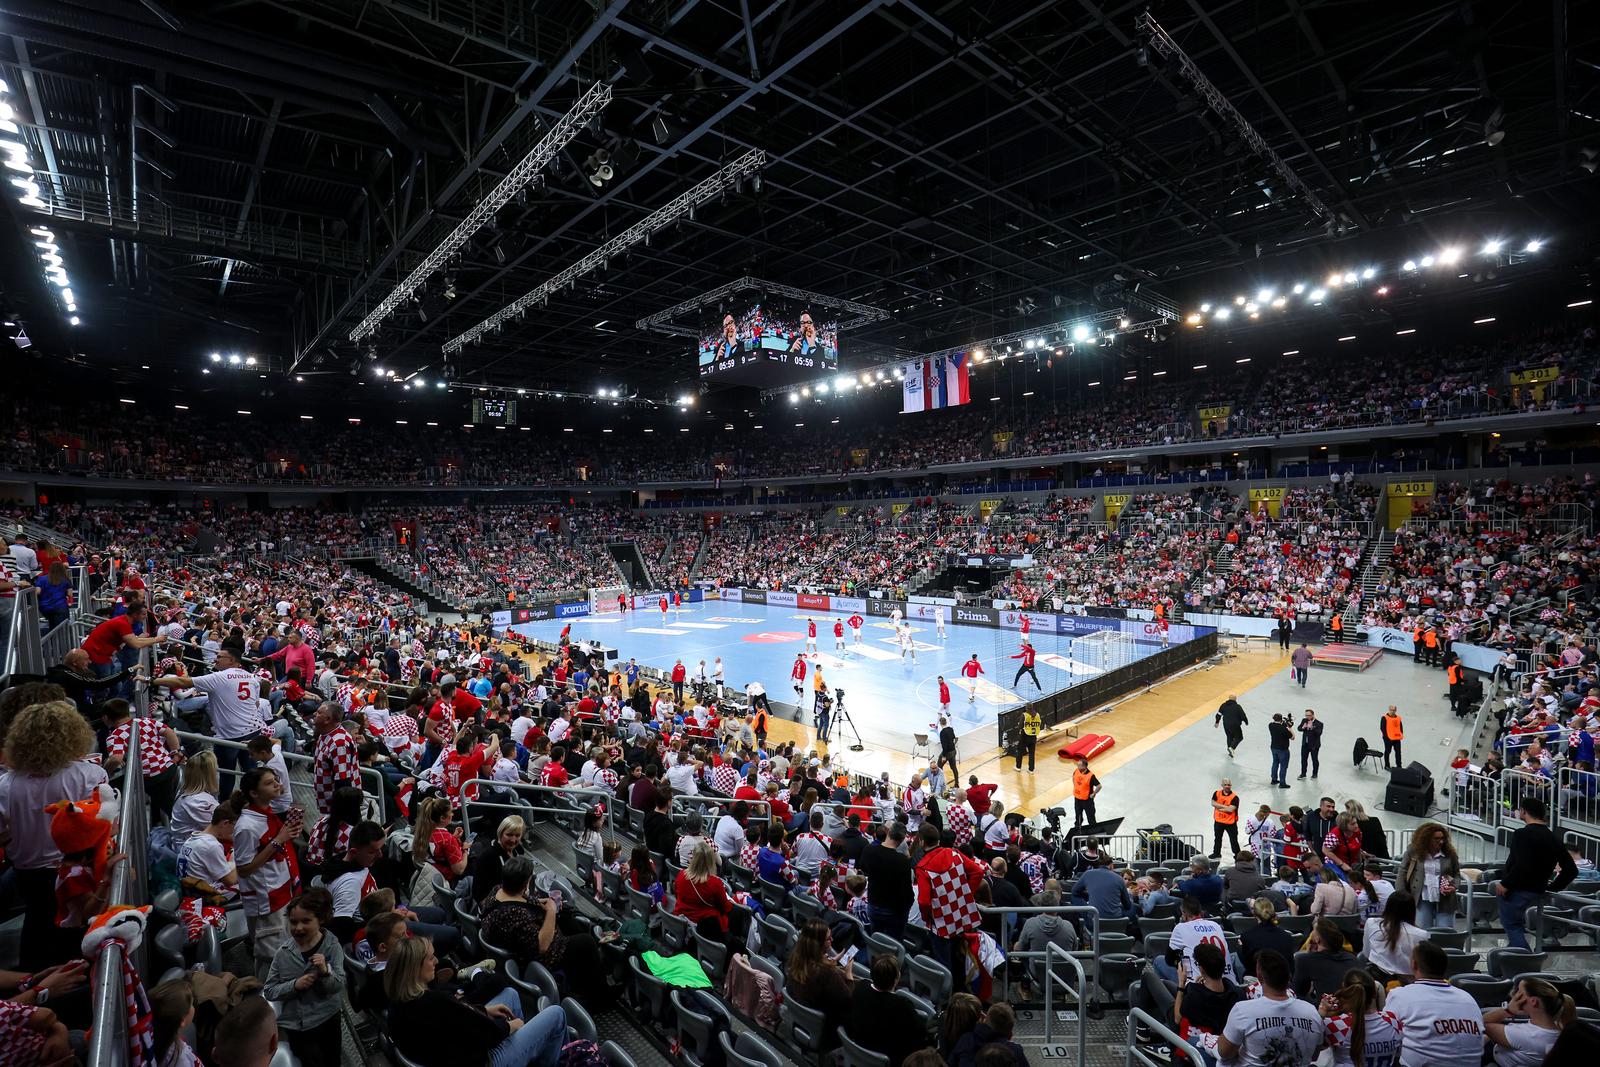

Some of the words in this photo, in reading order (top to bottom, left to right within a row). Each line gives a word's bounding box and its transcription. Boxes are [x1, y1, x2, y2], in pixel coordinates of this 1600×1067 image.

[708, 365, 714, 373] 17
[718, 358, 735, 371] 05:59
[741, 356, 746, 364] 9
[780, 354, 788, 362] 17
[794, 356, 814, 367] 05:59
[821, 361, 826, 369] 9
[905, 377, 917, 388] EHF
[1263, 489, 1281, 497] 102
[1395, 484, 1402, 493] A
[1406, 483, 1426, 492] 101
[769, 594, 794, 603] VALAMAR
[529, 609, 548, 618] triglav
[957, 610, 992, 623] Prima.
[237, 682, 251, 701] 5
[550, 723, 557, 732] 5
[448, 770, 460, 788] 10
[1022, 1011, 1034, 1020] 9
[1255, 1016, 1287, 1031] CRIME
[1290, 1017, 1316, 1033] TIME
[1433, 1018, 1481, 1036] CROATIA
[1042, 1046, 1067, 1058] 10
